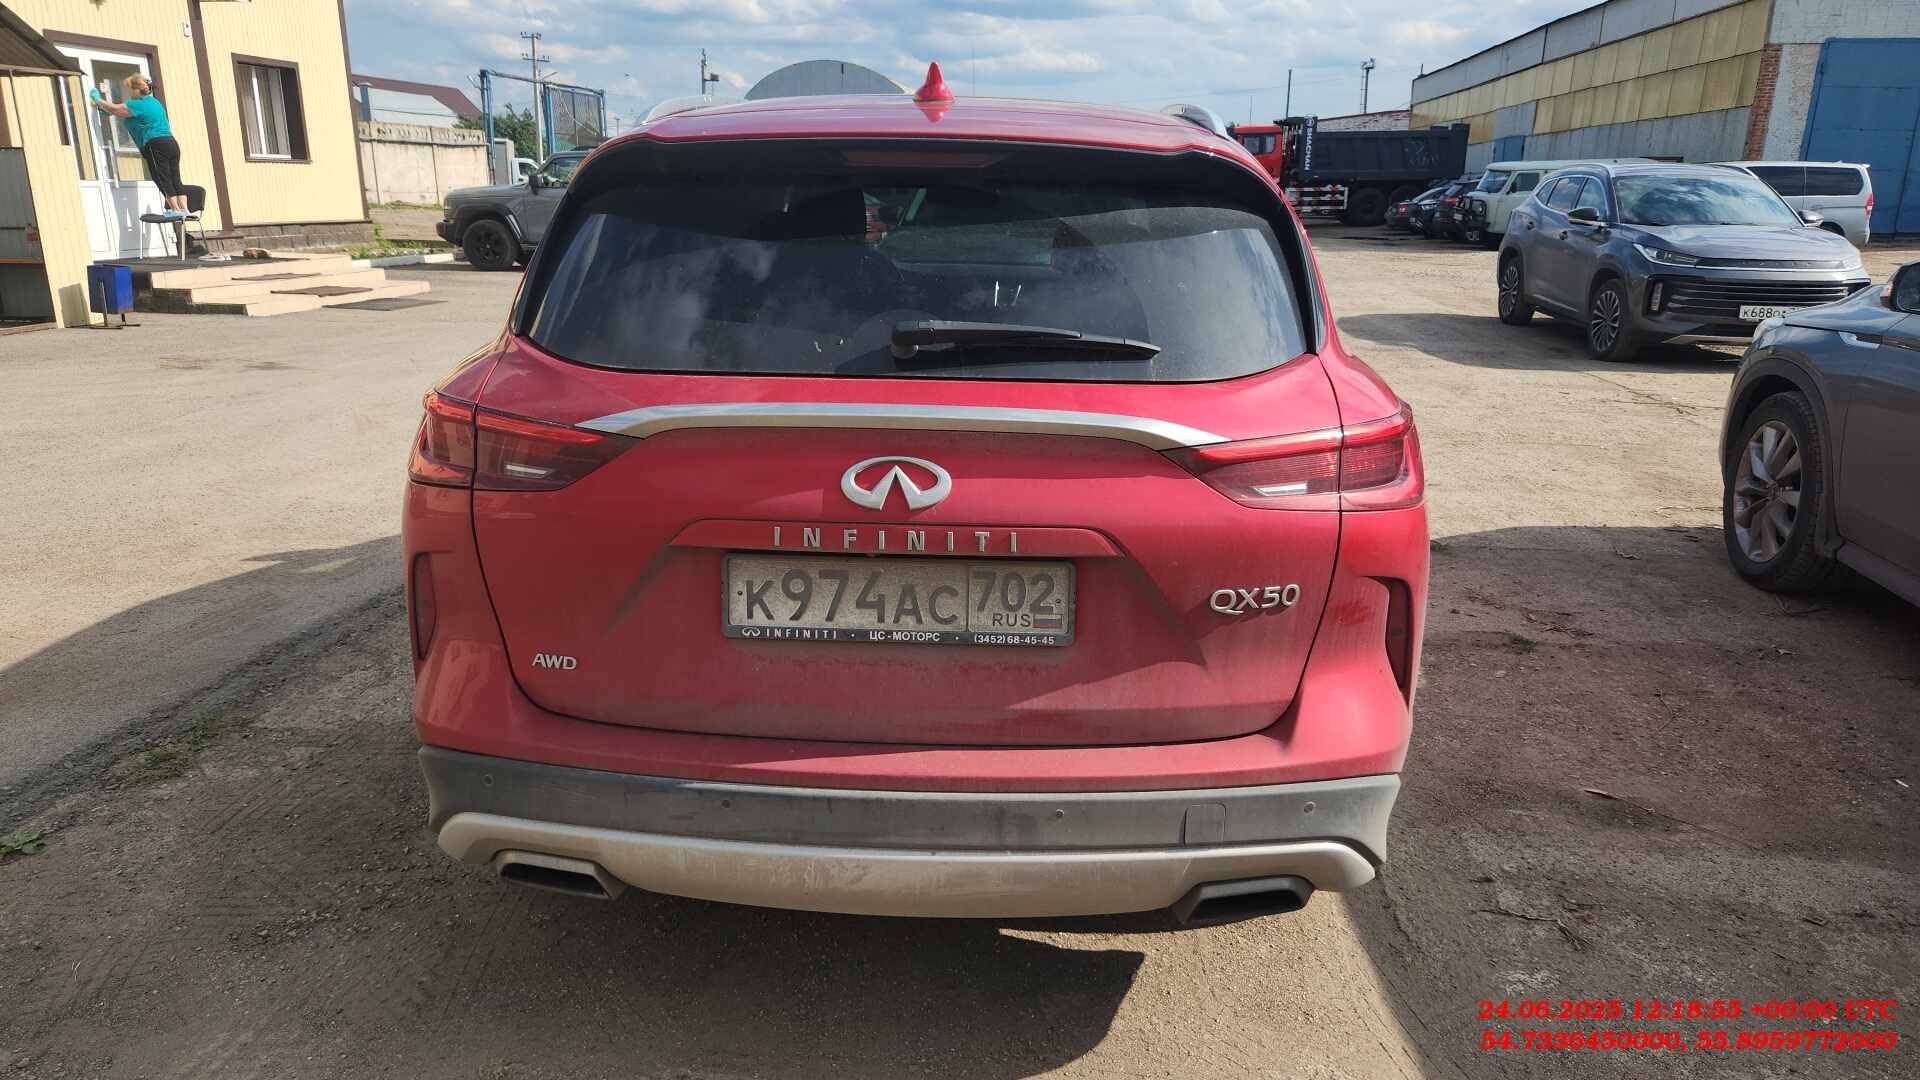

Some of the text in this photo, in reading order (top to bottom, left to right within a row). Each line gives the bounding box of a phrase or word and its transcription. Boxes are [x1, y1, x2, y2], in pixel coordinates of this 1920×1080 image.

[773, 526, 1018, 553] INFINITI
[973, 571, 1056, 613] 702
[1210, 583, 1301, 616] QX50
[991, 612, 1032, 629] RUS
[766, 629, 838, 640] INFINITI
[531, 652, 578, 670] AWD
